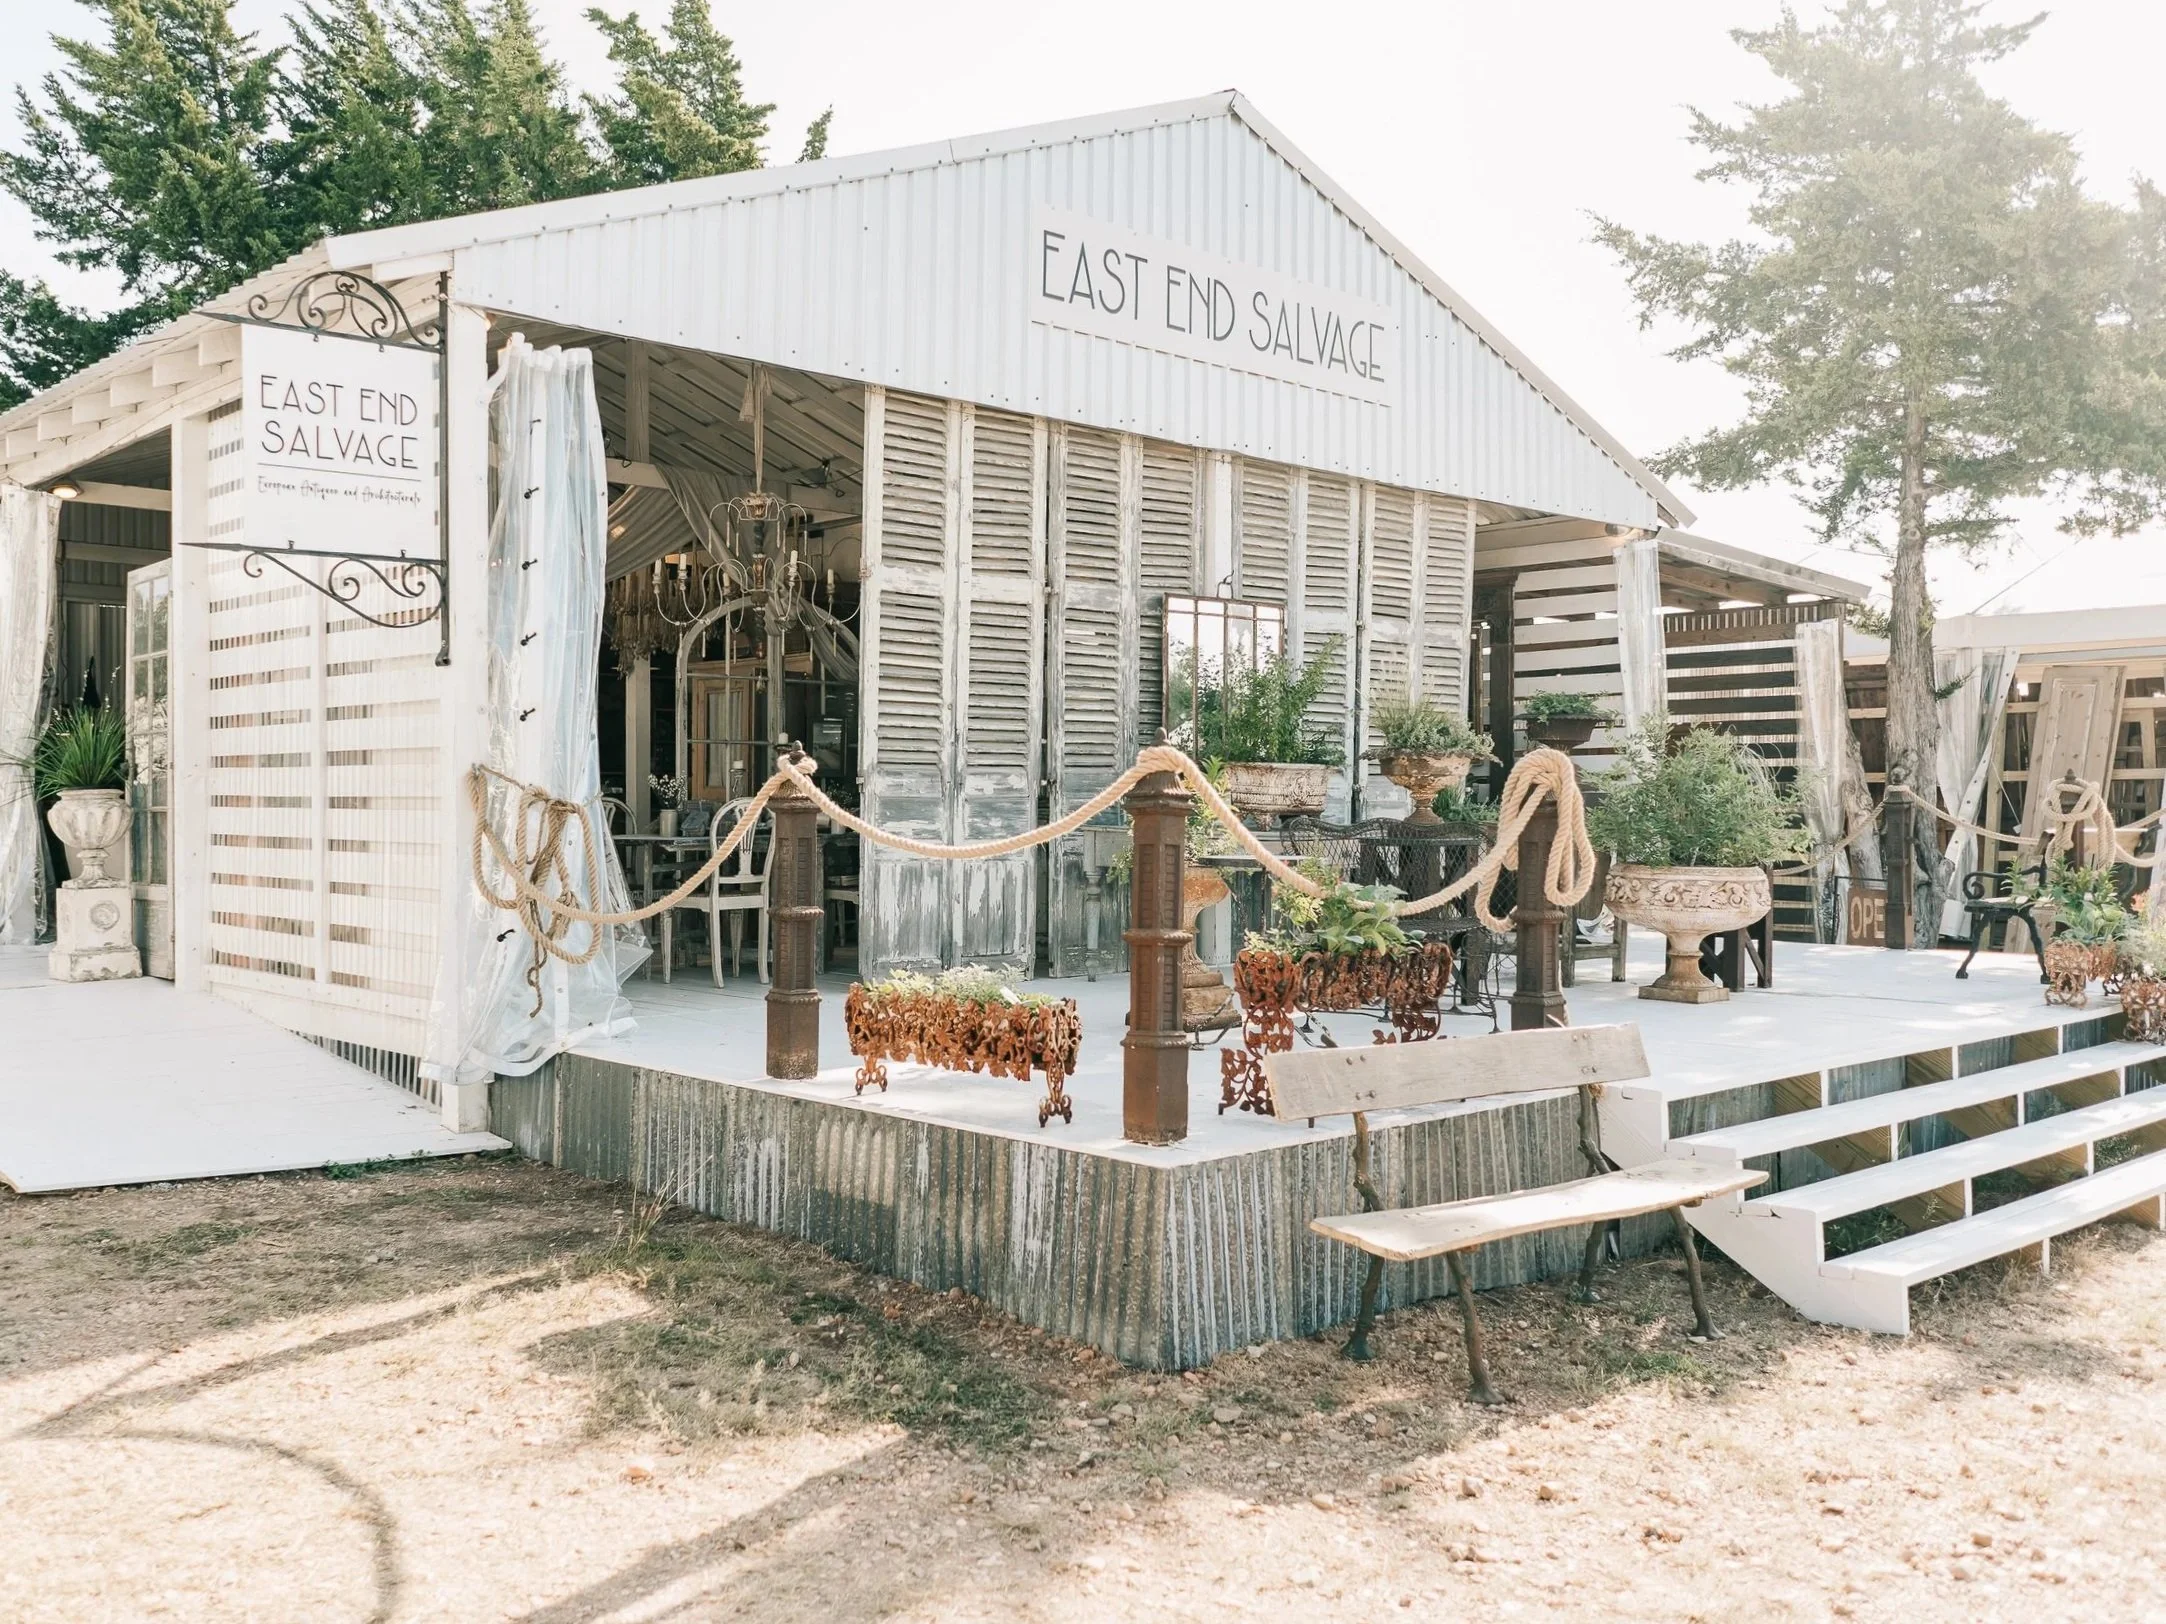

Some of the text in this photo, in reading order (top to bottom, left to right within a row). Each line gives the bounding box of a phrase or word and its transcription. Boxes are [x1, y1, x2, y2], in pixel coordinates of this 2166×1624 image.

[1043, 229, 1385, 383] EAST END SALVAGE
[260, 374, 418, 426] EAST END
[261, 420, 419, 470] SALVAGE
[257, 475, 297, 496] European
[343, 485, 359, 501] and
[1850, 896, 1886, 939] OPE
